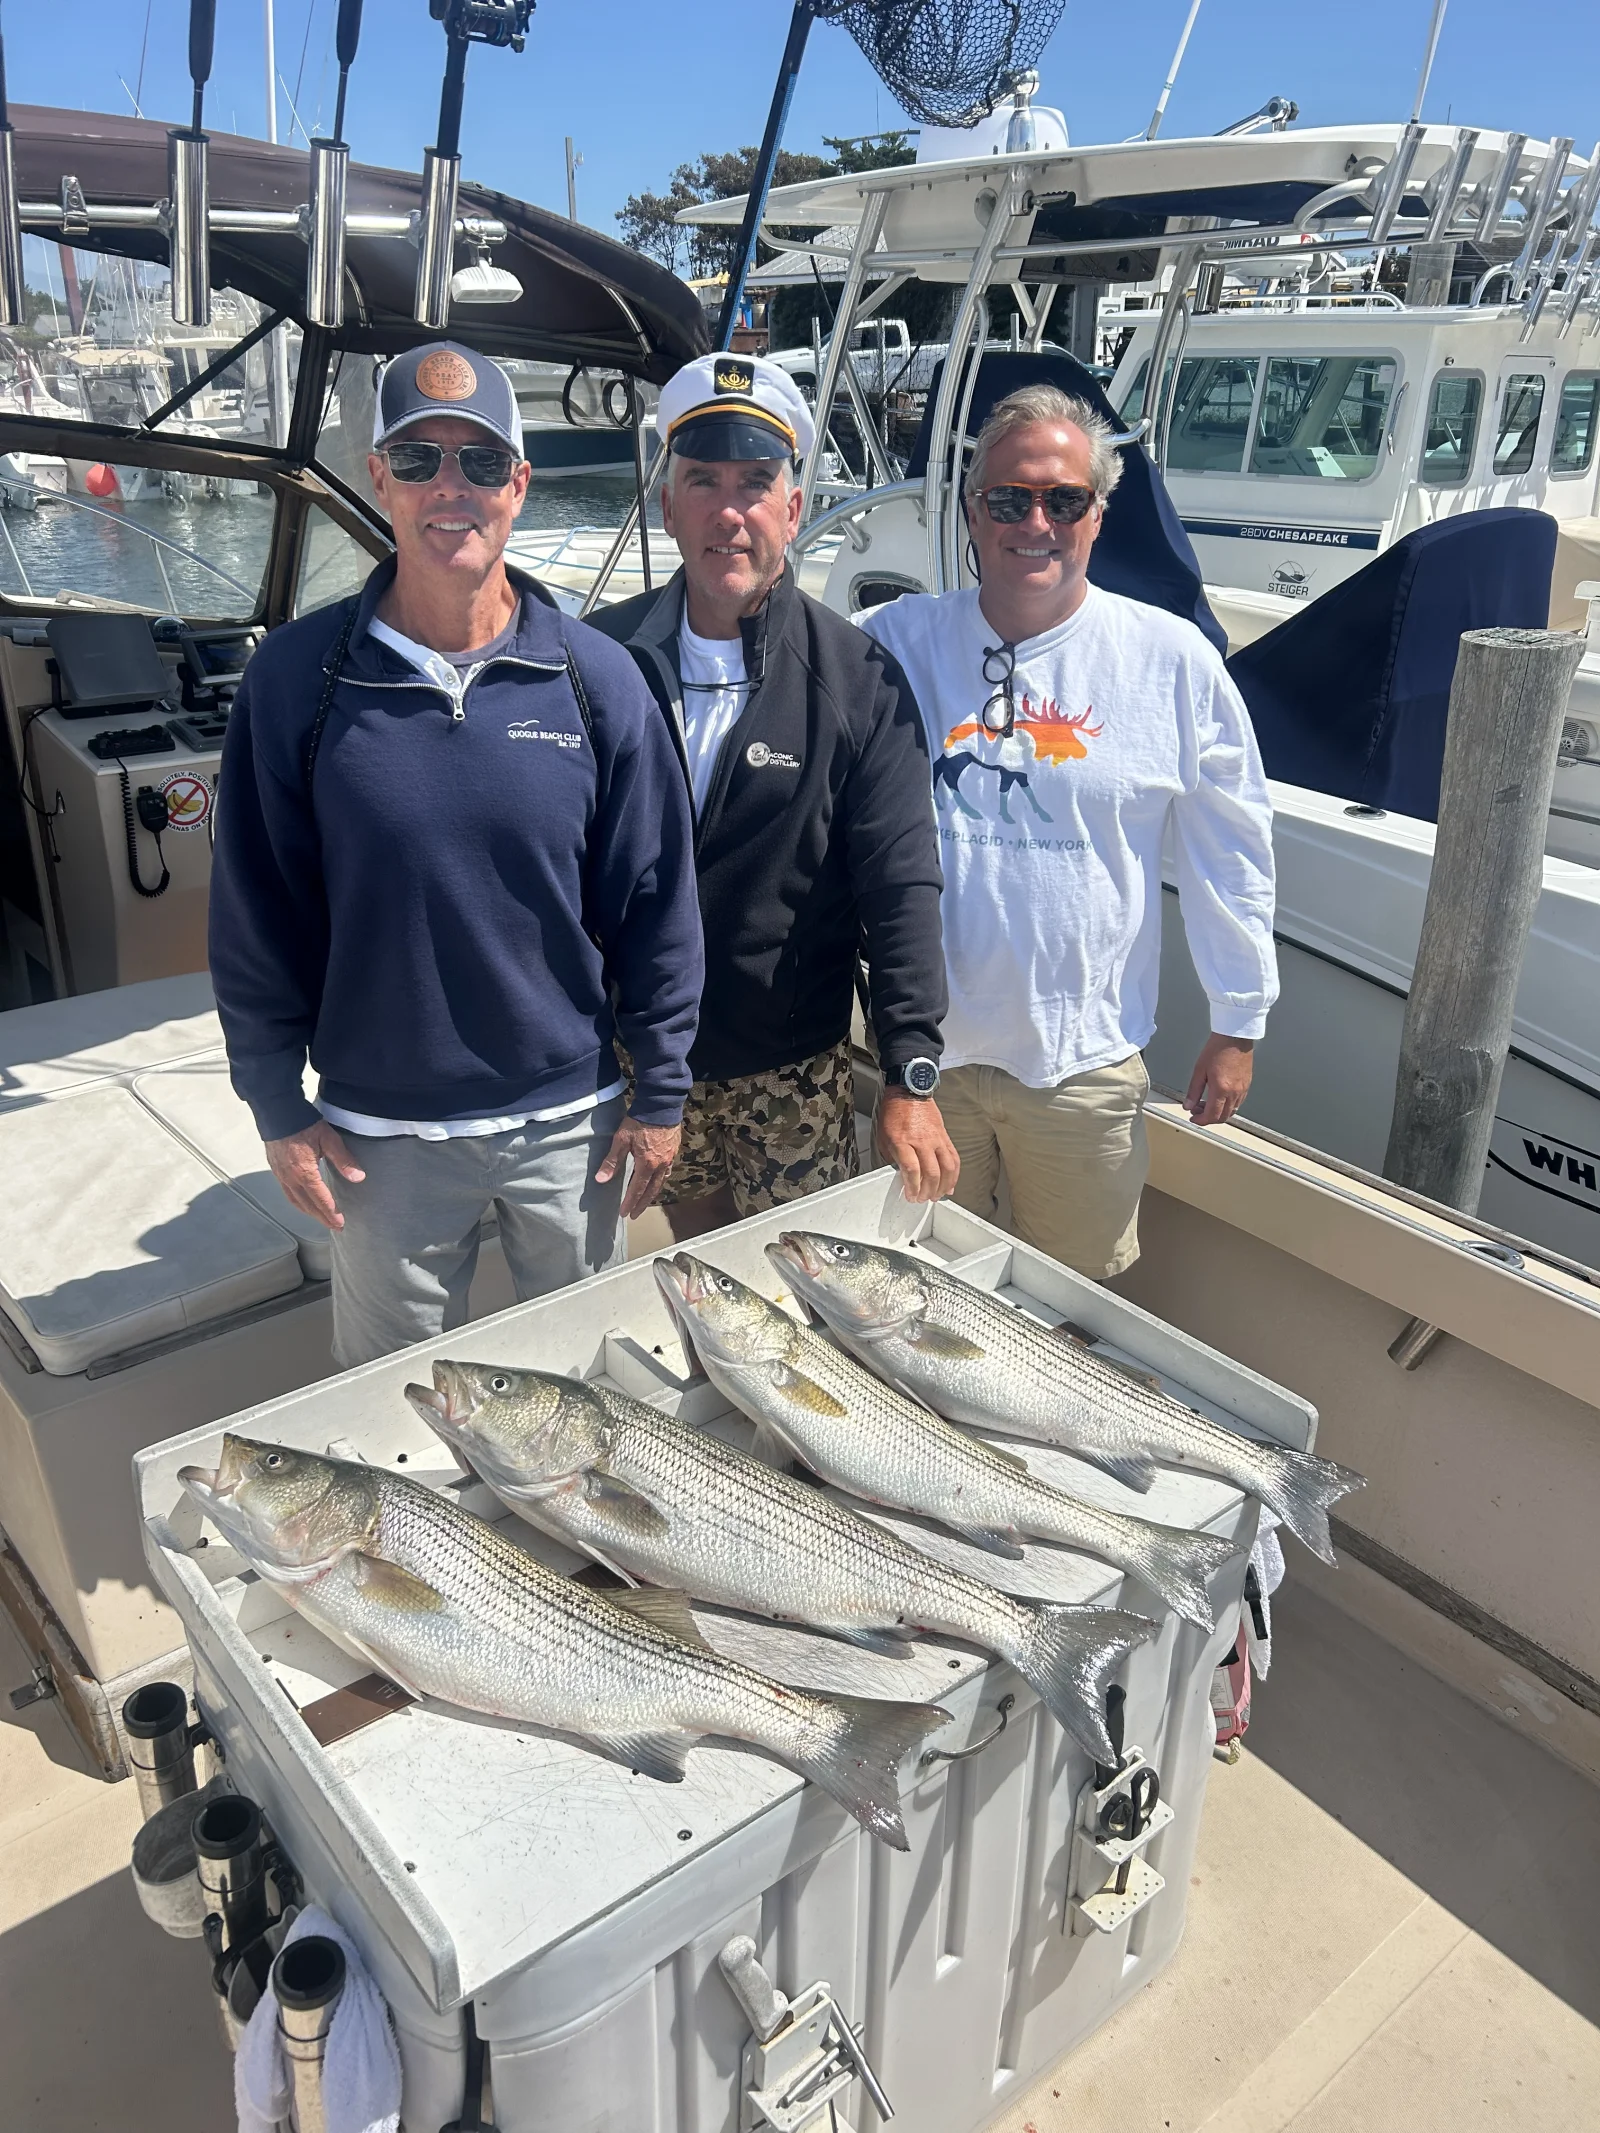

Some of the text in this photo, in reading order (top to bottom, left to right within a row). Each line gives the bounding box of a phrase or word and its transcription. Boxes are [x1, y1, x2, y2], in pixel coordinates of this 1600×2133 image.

[1268, 582, 1309, 596] STEIGER
[508, 730, 582, 742] QUOGUE BEACH CLUB
[167, 822, 189, 832] NANAS
[1017, 838, 1052, 850] NEW
[1056, 839, 1094, 851] YORK
[1522, 1137, 1600, 1192] WH
